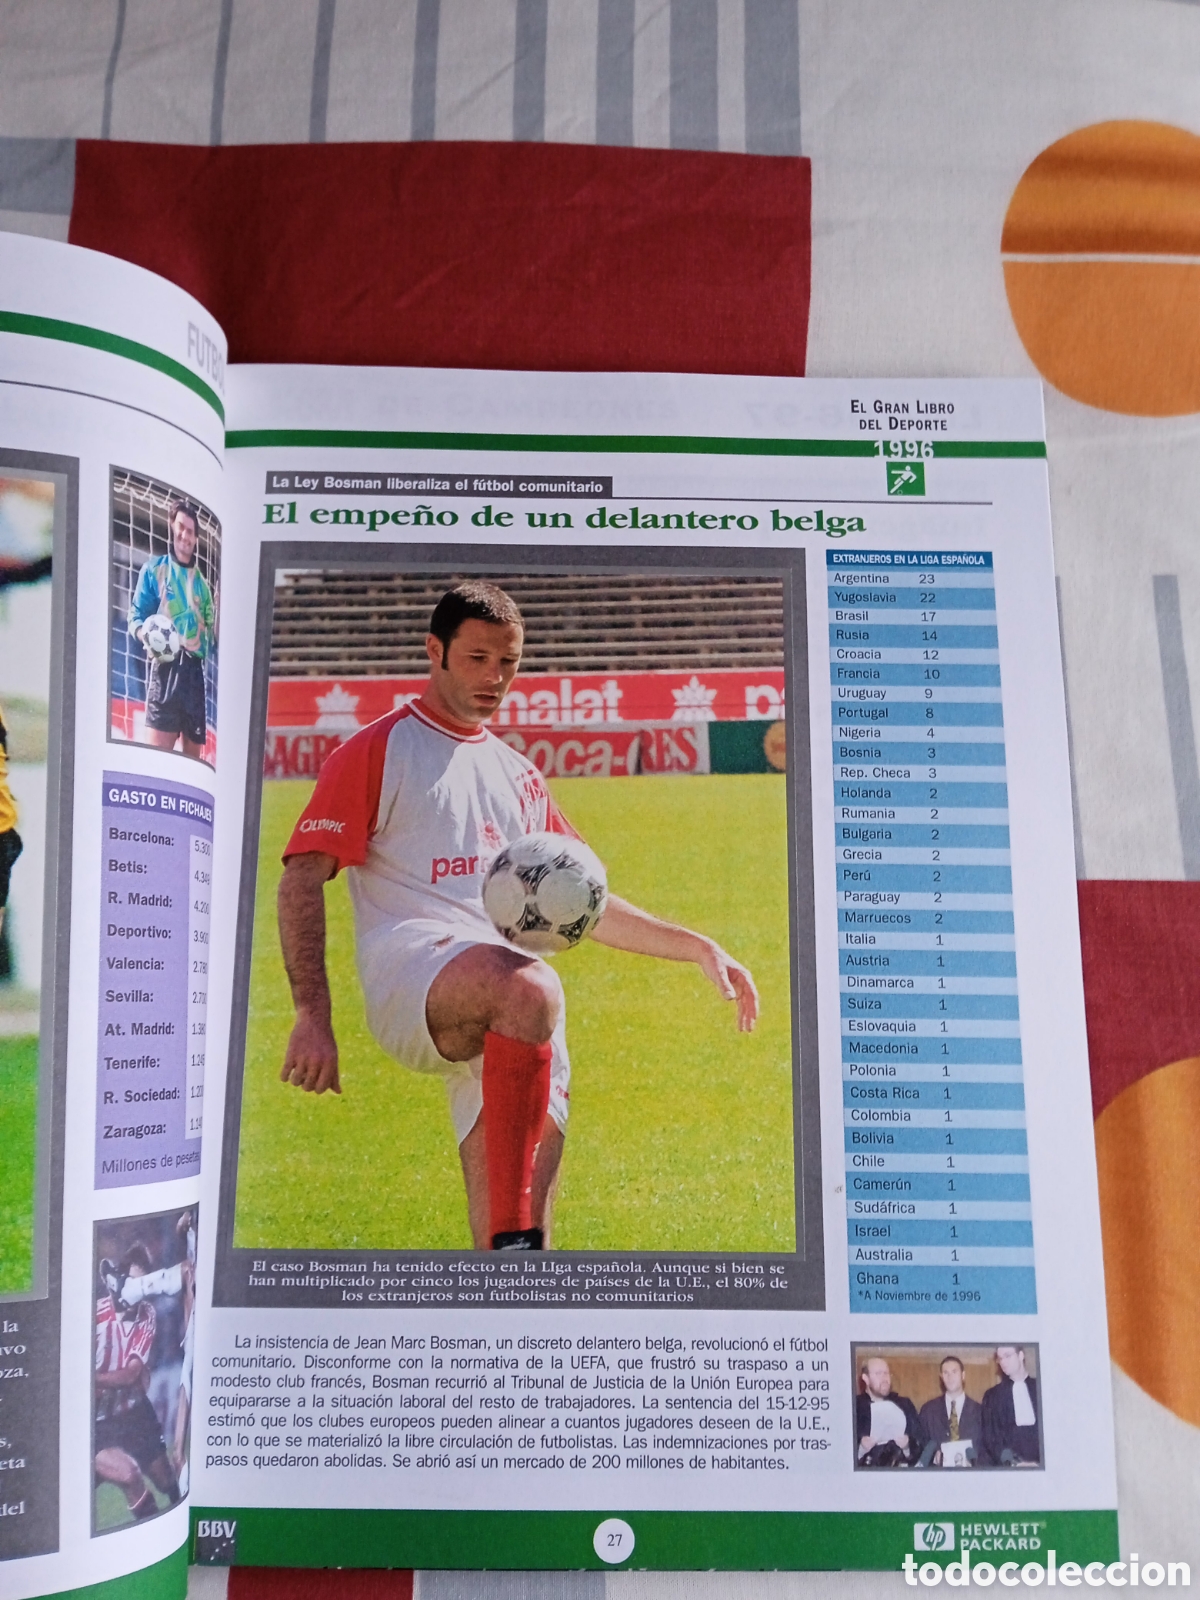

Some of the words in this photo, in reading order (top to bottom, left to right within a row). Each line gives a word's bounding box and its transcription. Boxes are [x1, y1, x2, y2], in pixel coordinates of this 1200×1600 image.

[850, 400, 867, 414] EL
[873, 400, 910, 414] GRAN
[916, 400, 955, 414] LIBRO
[859, 419, 882, 430] DEL
[888, 416, 948, 431] DEPORTE
[873, 440, 934, 458] 1996
[272, 476, 289, 488] La
[294, 476, 319, 491] Ley
[324, 476, 382, 489] Bosman
[387, 478, 450, 490] liberaliza
[455, 478, 468, 491] el
[472, 478, 514, 492] fútbol
[518, 480, 604, 493] comunitario
[262, 501, 299, 524] El
[310, 504, 459, 532] empeño
[471, 504, 514, 528] de
[524, 512, 574, 529] un
[585, 506, 759, 531] delantero
[770, 509, 867, 538] belga
[832, 553, 892, 564] EXTRANJEROS
[894, 554, 906, 564] EN
[907, 554, 919, 564] LA
[920, 555, 940, 565] LIGA
[941, 554, 985, 565] ESPAÑOLA
[834, 572, 890, 586] Argentina
[919, 574, 935, 585] 23
[834, 591, 897, 605] Yugoslavia
[920, 592, 936, 603] 22
[835, 610, 869, 621] Brasil
[921, 611, 936, 622] 17
[836, 629, 870, 640] Rusia
[922, 630, 938, 641] 14
[836, 648, 882, 660] Croacia
[923, 650, 939, 660] 12
[837, 668, 880, 679] Francia
[924, 668, 940, 680] 10
[838, 687, 887, 701] Uruguay
[924, 688, 933, 699] 9
[838, 707, 889, 721] Portugal
[925, 707, 934, 719] 8
[839, 726, 881, 740] Nigeria
[926, 728, 935, 738] 4
[840, 746, 882, 758] Bosnia
[928, 747, 936, 759] 3
[840, 766, 868, 780] Rep.
[872, 767, 911, 779] Checa
[928, 768, 937, 779] 3
[841, 786, 892, 799] Holanda
[929, 788, 938, 800] 2
[108, 788, 157, 807] GASTO
[160, 795, 176, 811] EN
[179, 799, 212, 823] FICHAJES
[842, 807, 896, 819] Rumania
[930, 808, 939, 820] 2
[299, 818, 346, 834] OLYMPIC
[108, 827, 175, 846] Barcelona:
[842, 827, 892, 842] Bulgaria
[931, 829, 940, 840] 2
[842, 848, 882, 860] Grecia
[932, 850, 940, 861] 2
[108, 859, 148, 874] Betis:
[843, 869, 871, 881] Perú
[933, 870, 941, 882] 2
[107, 891, 122, 904] R.
[127, 892, 173, 908] Madrid:
[844, 890, 901, 905] Paraguay
[934, 892, 942, 903] 2
[845, 910, 912, 924] Marruecos
[934, 912, 943, 925] 2
[106, 923, 172, 939] Deportivo:
[106, 956, 165, 971] Valencia:
[105, 989, 154, 1003] Sevilla:
[104, 1023, 126, 1037] At.
[131, 1022, 175, 1036] Madrid:
[848, 1020, 916, 1034] Eslovaquia
[940, 1020, 948, 1033] 1
[104, 1055, 160, 1071] Tenerife:
[103, 1091, 119, 1104] R.
[123, 1087, 180, 1103] Sociedad:
[850, 1086, 888, 1099] Costa
[892, 1086, 920, 1099] Rica
[944, 1087, 952, 1100] 1
[102, 1123, 167, 1139] Zaragoza:
[101, 1158, 157, 1174] Millones
[160, 1154, 173, 1168] de
[853, 1178, 912, 1191] Camerún
[948, 1179, 956, 1192] 1
[854, 1201, 916, 1214] Sudáfrica
[949, 1202, 958, 1215] 1
[855, 1248, 913, 1261] Australia
[951, 1249, 960, 1262] 1
[252, 1260, 266, 1272] El
[271, 1264, 304, 1272] caso
[309, 1261, 367, 1272] Bosman
[373, 1261, 390, 1272] ha
[396, 1261, 444, 1272] tenido
[448, 1261, 496, 1272] efecto
[500, 1264, 518, 1272] en
[524, 1261, 536, 1272] la
[542, 1262, 572, 1276] LIga
[577, 1261, 646, 1276] española.
[652, 1262, 710, 1276] Aunque
[715, 1262, 726, 1274] si
[732, 1262, 764, 1274] bien
[769, 1266, 785, 1274] se
[856, 1272, 899, 1285] Ghana
[952, 1273, 960, 1286] 1
[875, 1290, 931, 1302] Noviembre
[934, 1291, 948, 1302] de
[952, 1290, 981, 1302] 1996
[2, 1320, 19, 1333] la
[235, 1334, 252, 1349] La
[256, 1335, 329, 1350] insistencia
[332, 1335, 350, 1350] de
[354, 1335, 386, 1350] Jean
[391, 1335, 426, 1350] Marc
[430, 1335, 491, 1352] Bosman,
[496, 1338, 513, 1350] un
[517, 1336, 572, 1350] discreto
[576, 1336, 641, 1350] delantero
[645, 1336, 686, 1354] belga,
[691, 1337, 769, 1352] revolucionó
[773, 1337, 785, 1352] el
[789, 1337, 828, 1352] fútbol
[205, 1455, 248, 1469] pasos
[253, 1453, 319, 1470] quedaron
[324, 1453, 387, 1468] abolidas.
[392, 1453, 411, 1468] Se
[416, 1454, 451, 1468] abrió
[455, 1454, 477, 1469] así
[481, 1458, 499, 1469] un
[504, 1454, 565, 1469] mercado
[569, 1454, 587, 1469] de
[592, 1454, 621, 1469] 200
[626, 1454, 684, 1470] millones
[689, 1455, 707, 1470] de
[711, 1455, 789, 1470] habitantes.
[197, 1520, 237, 1538] BBV
[960, 1523, 1040, 1536] HEWLETT
[606, 1532, 623, 1548] 27
[960, 1537, 1041, 1551] PACKARD
